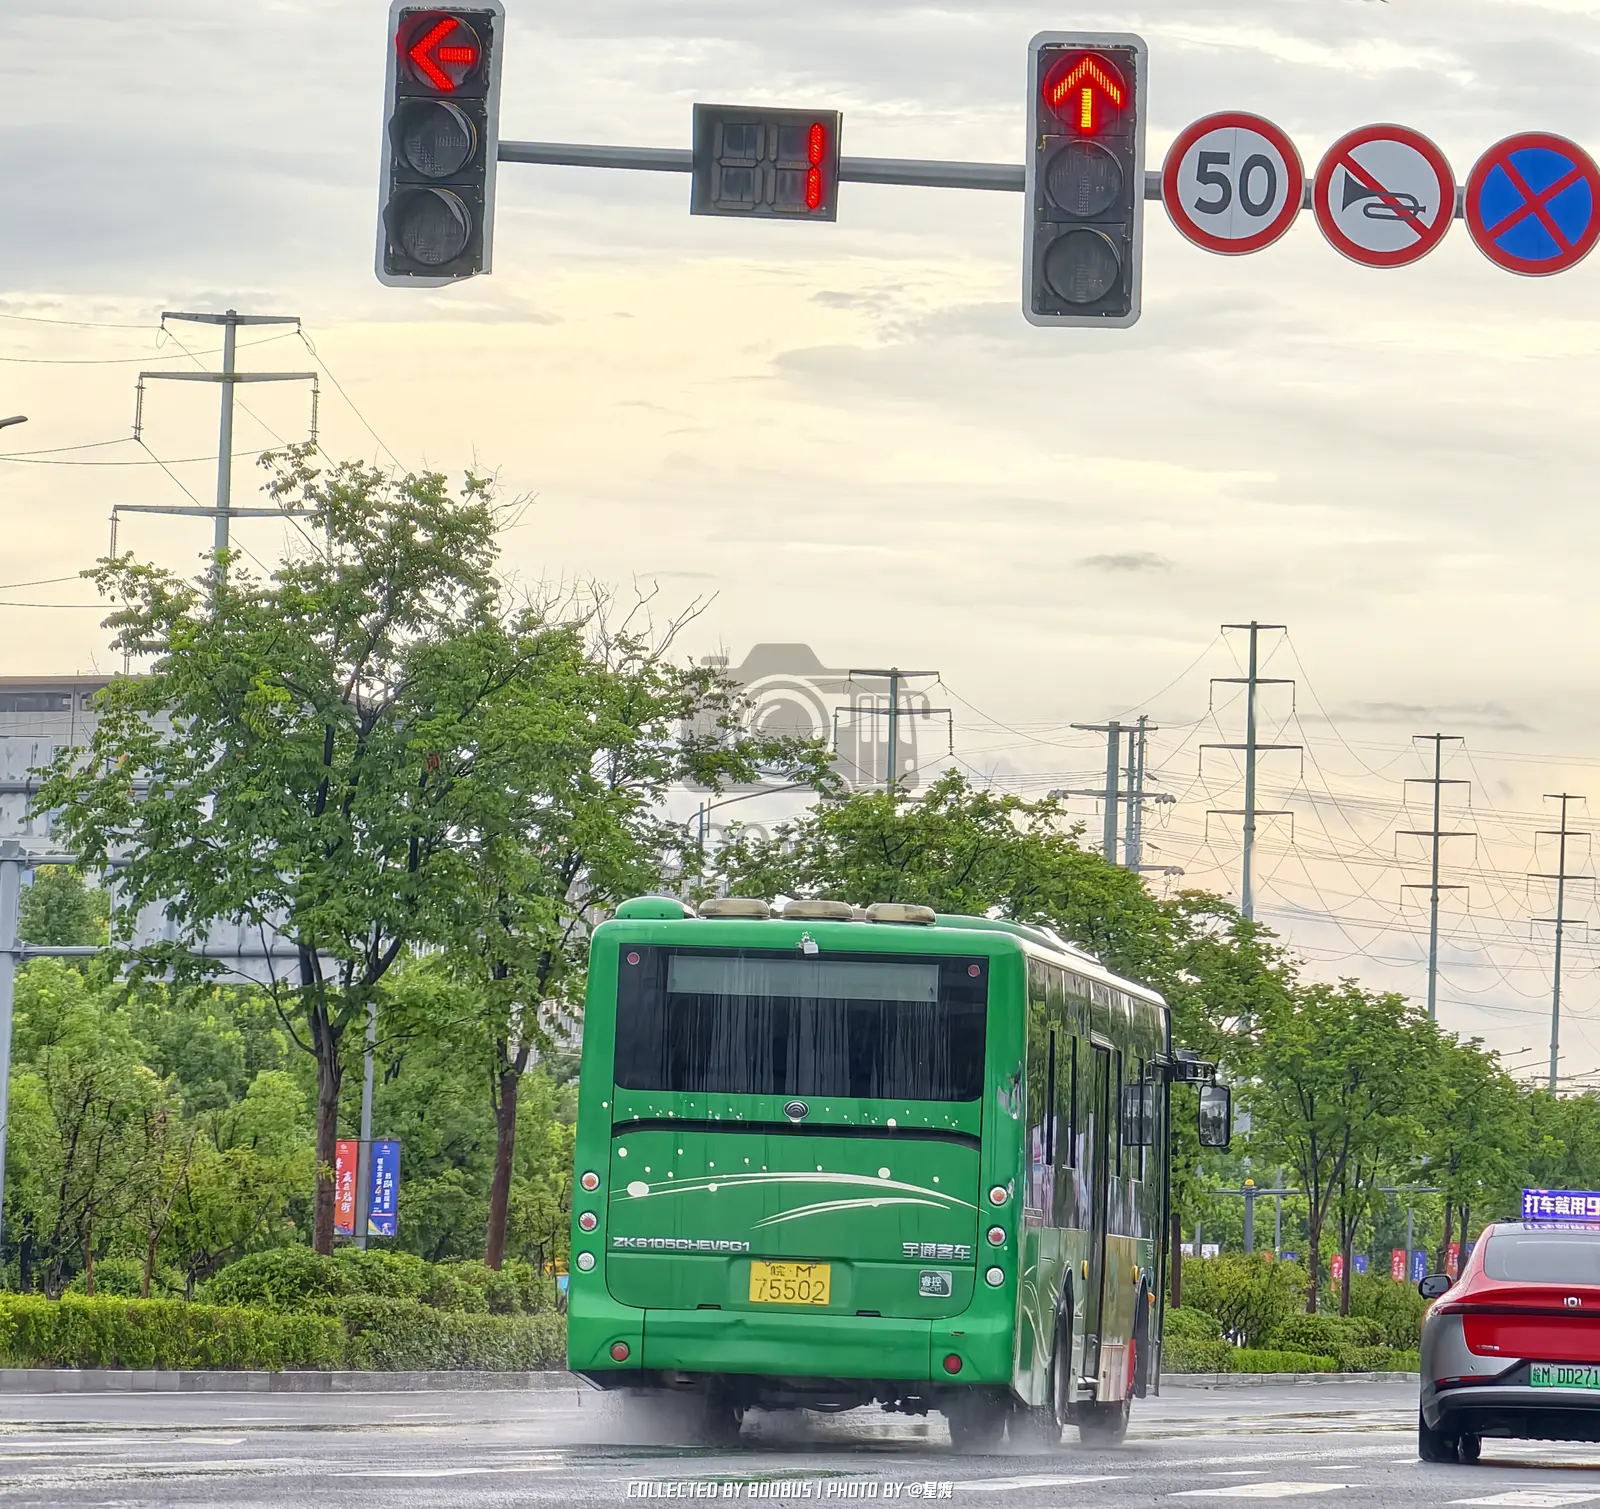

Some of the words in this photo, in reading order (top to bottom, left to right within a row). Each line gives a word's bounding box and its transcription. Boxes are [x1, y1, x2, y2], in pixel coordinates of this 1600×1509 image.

[805, 121, 824, 210] 1
[1193, 150, 1278, 218] 50
[612, 1236, 750, 1252] ZK6105CHEVPG1
[902, 1242, 971, 1260] 宇通客车
[755, 1278, 825, 1301] 75502
[921, 1276, 942, 1287] 睿控
[1557, 1368, 1599, 1386] DD271
